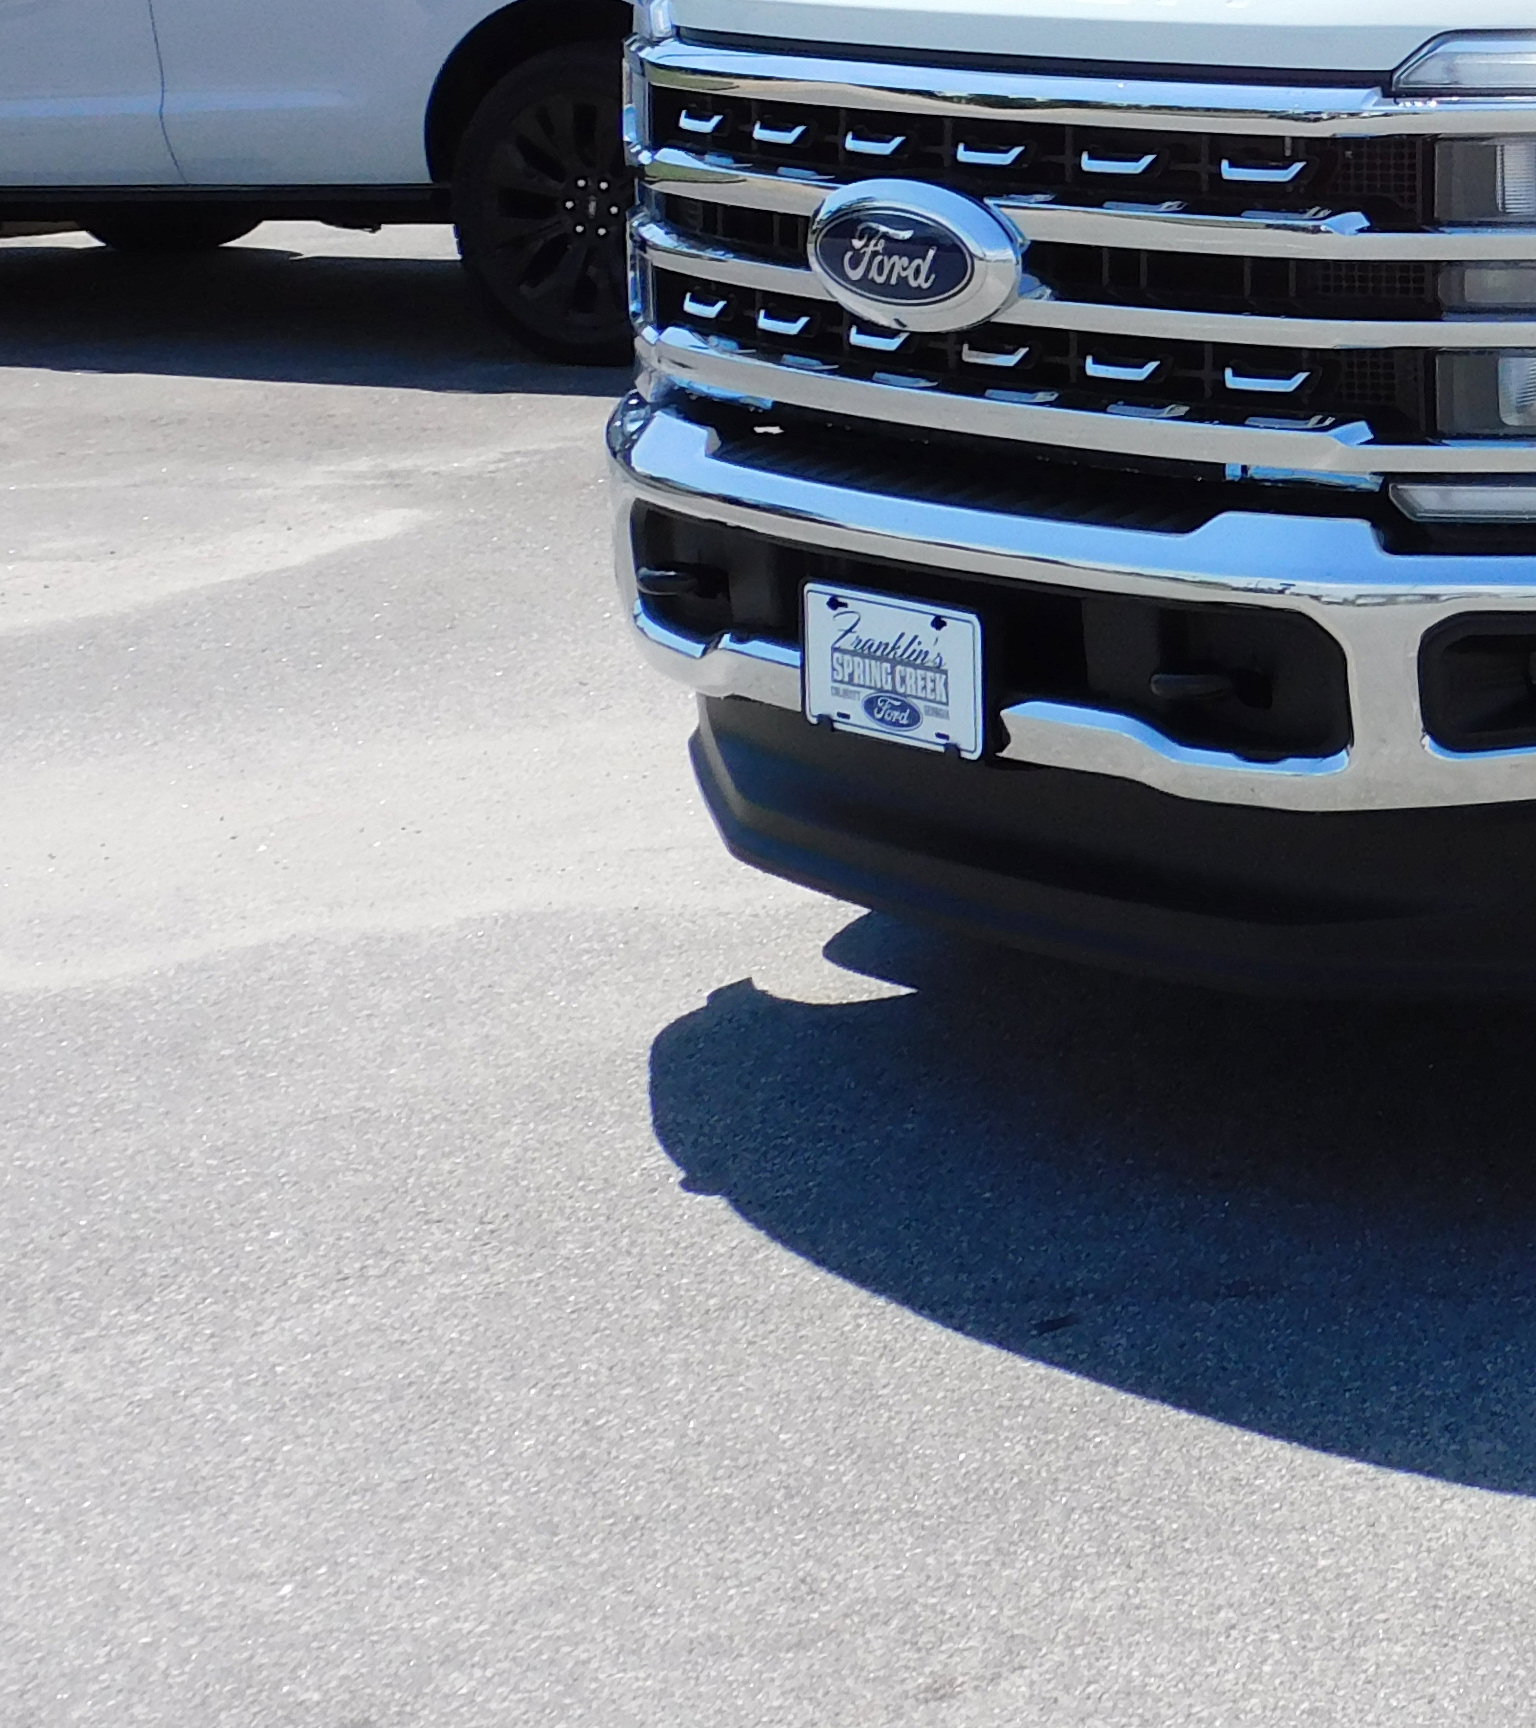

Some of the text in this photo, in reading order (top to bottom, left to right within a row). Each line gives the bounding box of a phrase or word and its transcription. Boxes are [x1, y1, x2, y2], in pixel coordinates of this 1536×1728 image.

[843, 222, 937, 289] Ford
[831, 611, 947, 669] Franklin's
[833, 652, 892, 691] SPRING
[895, 665, 948, 703] CREEK
[874, 697, 911, 725] Ford
